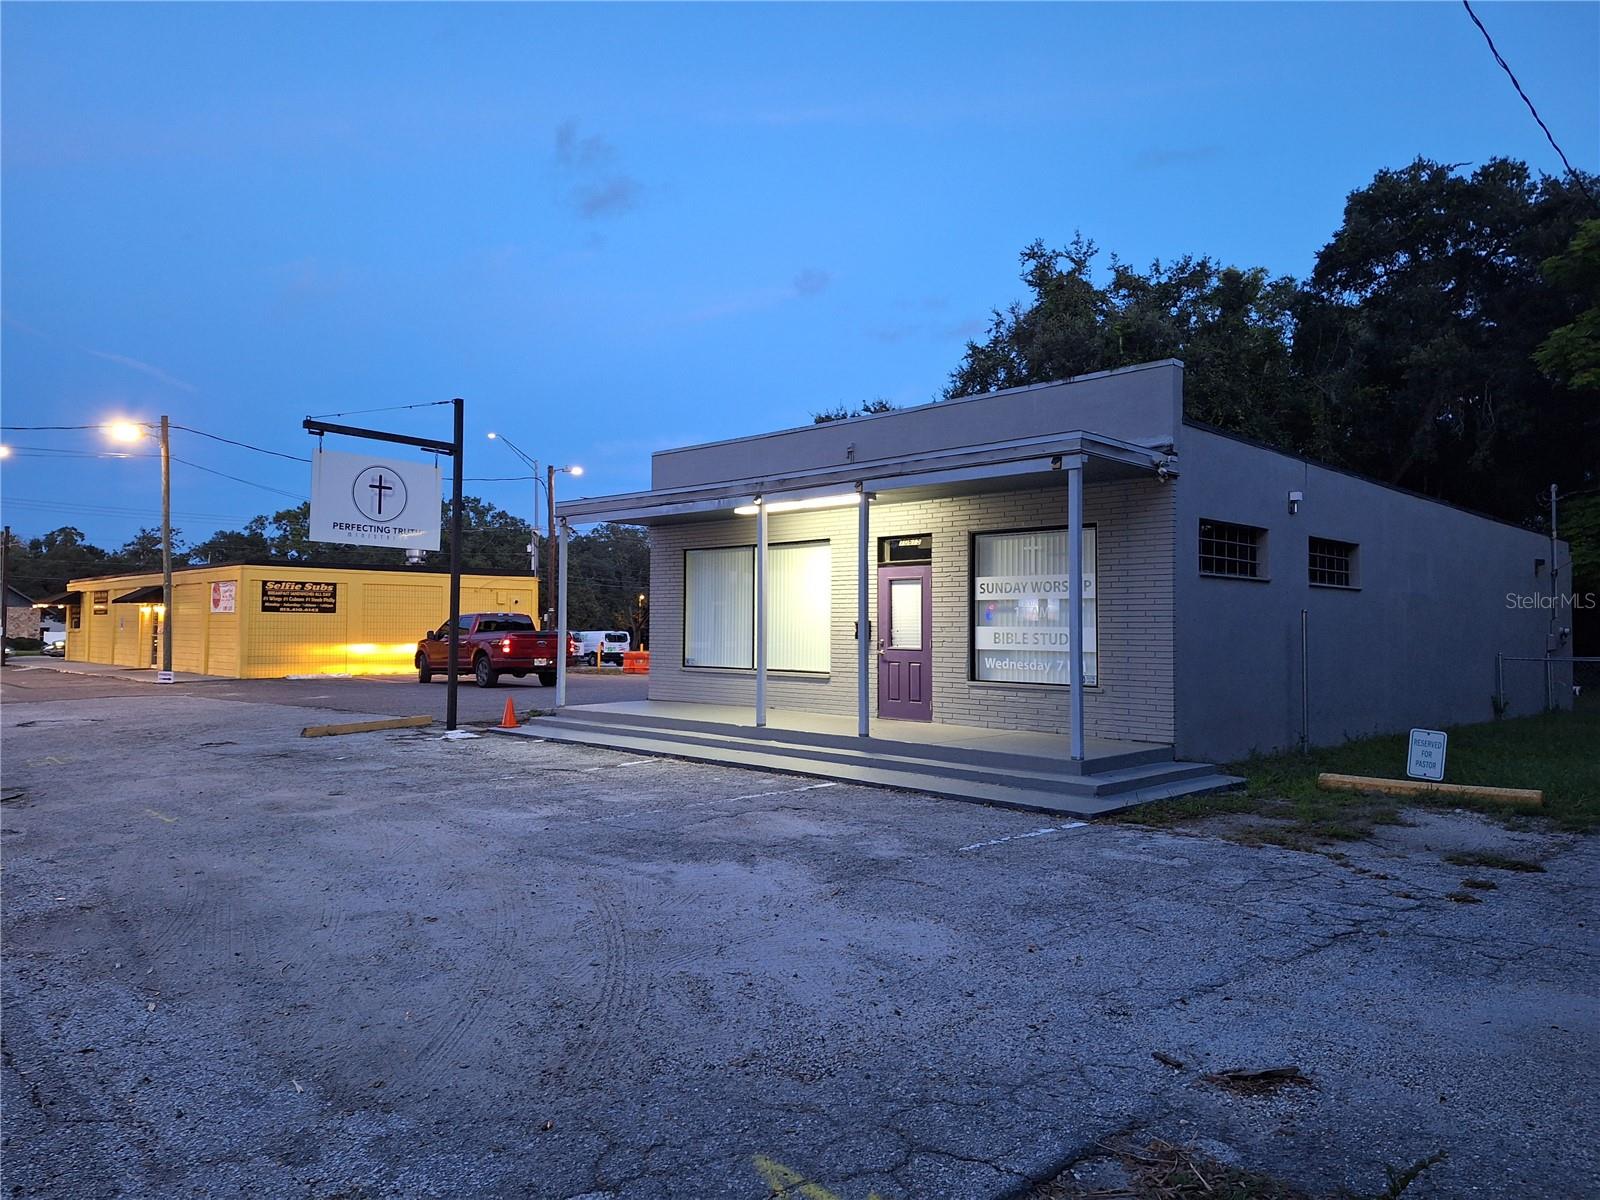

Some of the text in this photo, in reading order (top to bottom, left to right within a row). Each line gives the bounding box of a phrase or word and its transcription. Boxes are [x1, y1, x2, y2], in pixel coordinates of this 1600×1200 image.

[332, 521, 391, 534] PERFECTING
[265, 582, 334, 591] Selfie Subs
[979, 579, 1092, 594] SUNDAY WORSP
[993, 631, 1071, 646] BIBLE STUD
[985, 657, 1050, 673] Wednesday
[1056, 660, 1064, 672] 7
[1413, 738, 1442, 749] RESERVED
[1421, 750, 1433, 758] FOR
[1415, 760, 1437, 769] PASTOR
